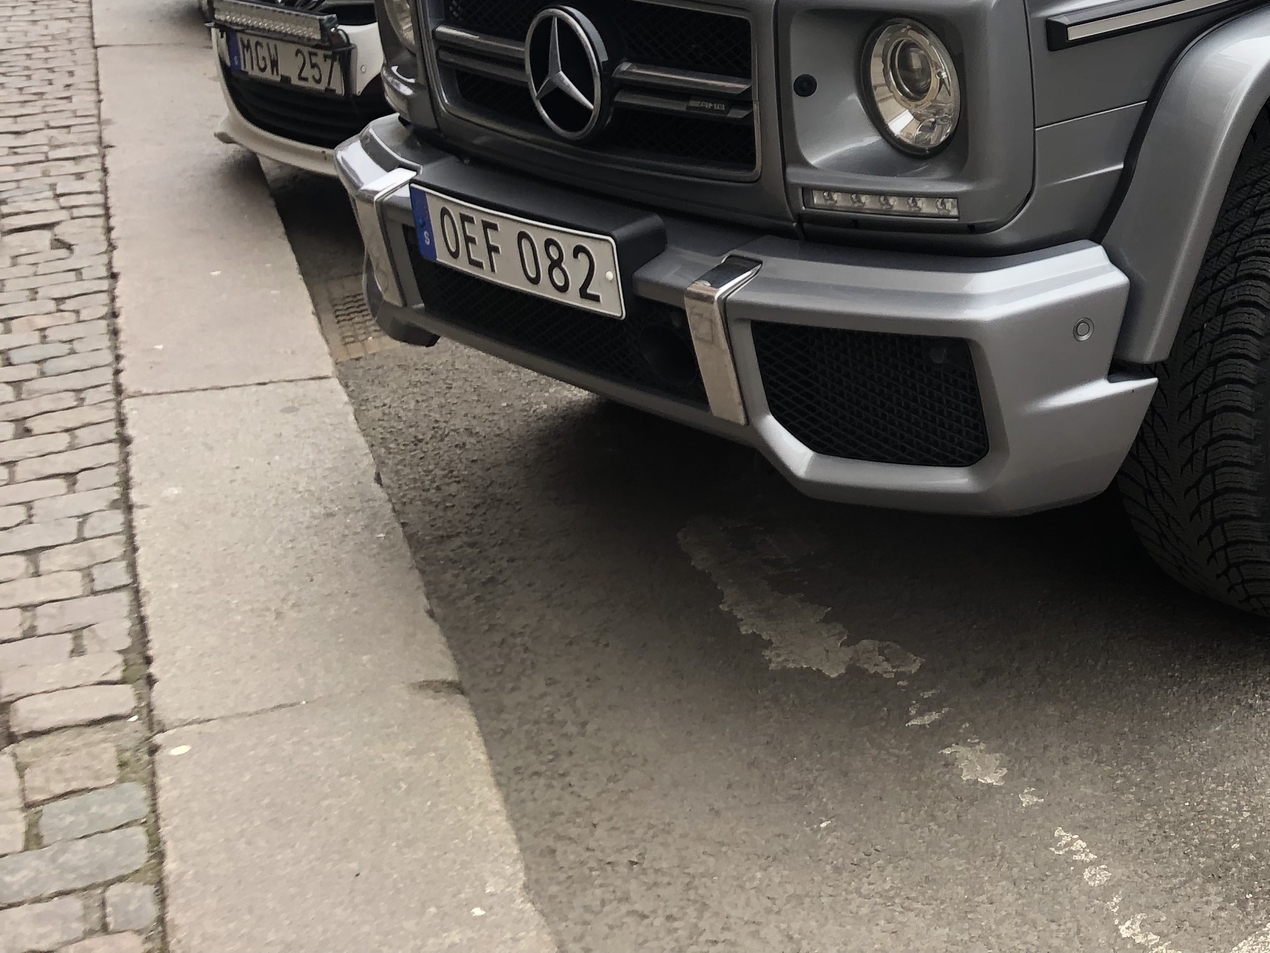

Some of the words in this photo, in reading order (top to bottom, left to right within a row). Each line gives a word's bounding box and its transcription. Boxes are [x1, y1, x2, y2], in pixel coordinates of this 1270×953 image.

[240, 36, 280, 77] MGW
[295, 48, 338, 88] 257
[423, 230, 431, 246] S
[439, 205, 502, 275] OEF
[516, 229, 602, 304] 082
